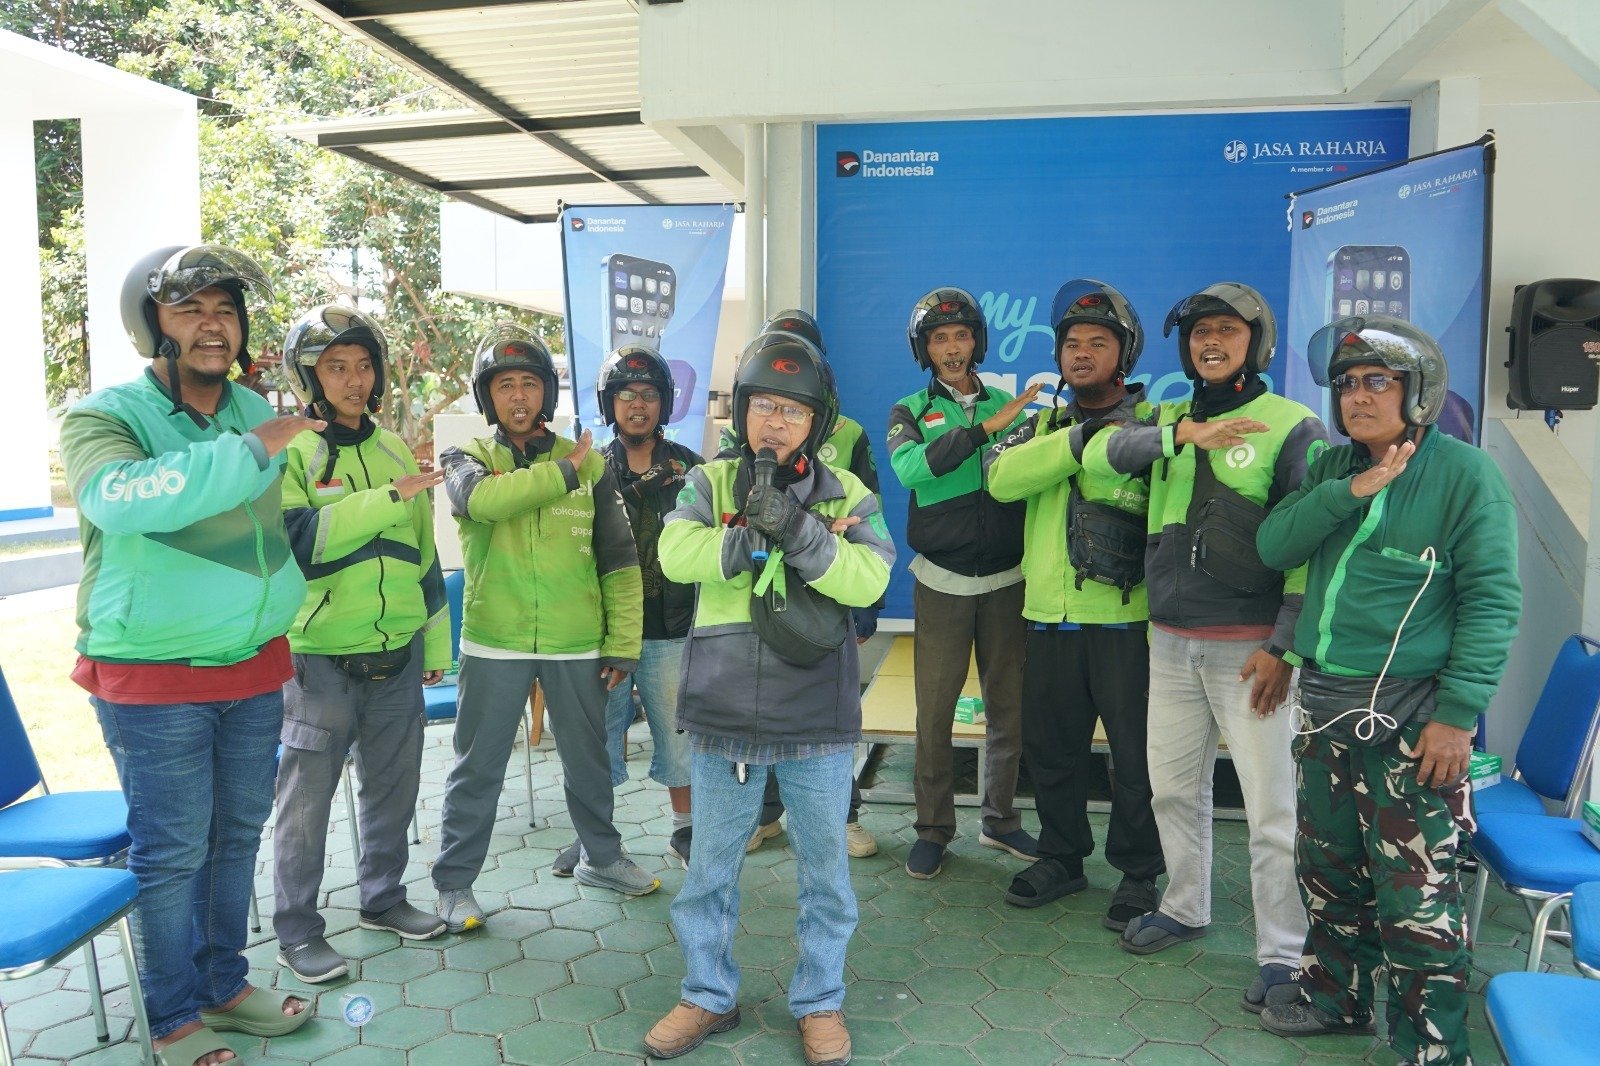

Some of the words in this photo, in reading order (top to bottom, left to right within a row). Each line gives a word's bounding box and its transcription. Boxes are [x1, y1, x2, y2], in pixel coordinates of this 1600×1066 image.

[863, 150, 939, 163] Danantara
[1252, 142, 1294, 159] JASA
[1299, 140, 1387, 158] RAHARJA
[863, 163, 934, 177] Indonesia
[1297, 165, 1325, 173] member
[1435, 169, 1478, 187] RAHARJA
[1316, 200, 1359, 216] Danantara
[587, 217, 627, 225] Danantara
[1315, 209, 1356, 226] Indonesia
[587, 225, 625, 233] Indonesia
[101, 465, 186, 502] Grab
[571, 526, 593, 538] gopa
